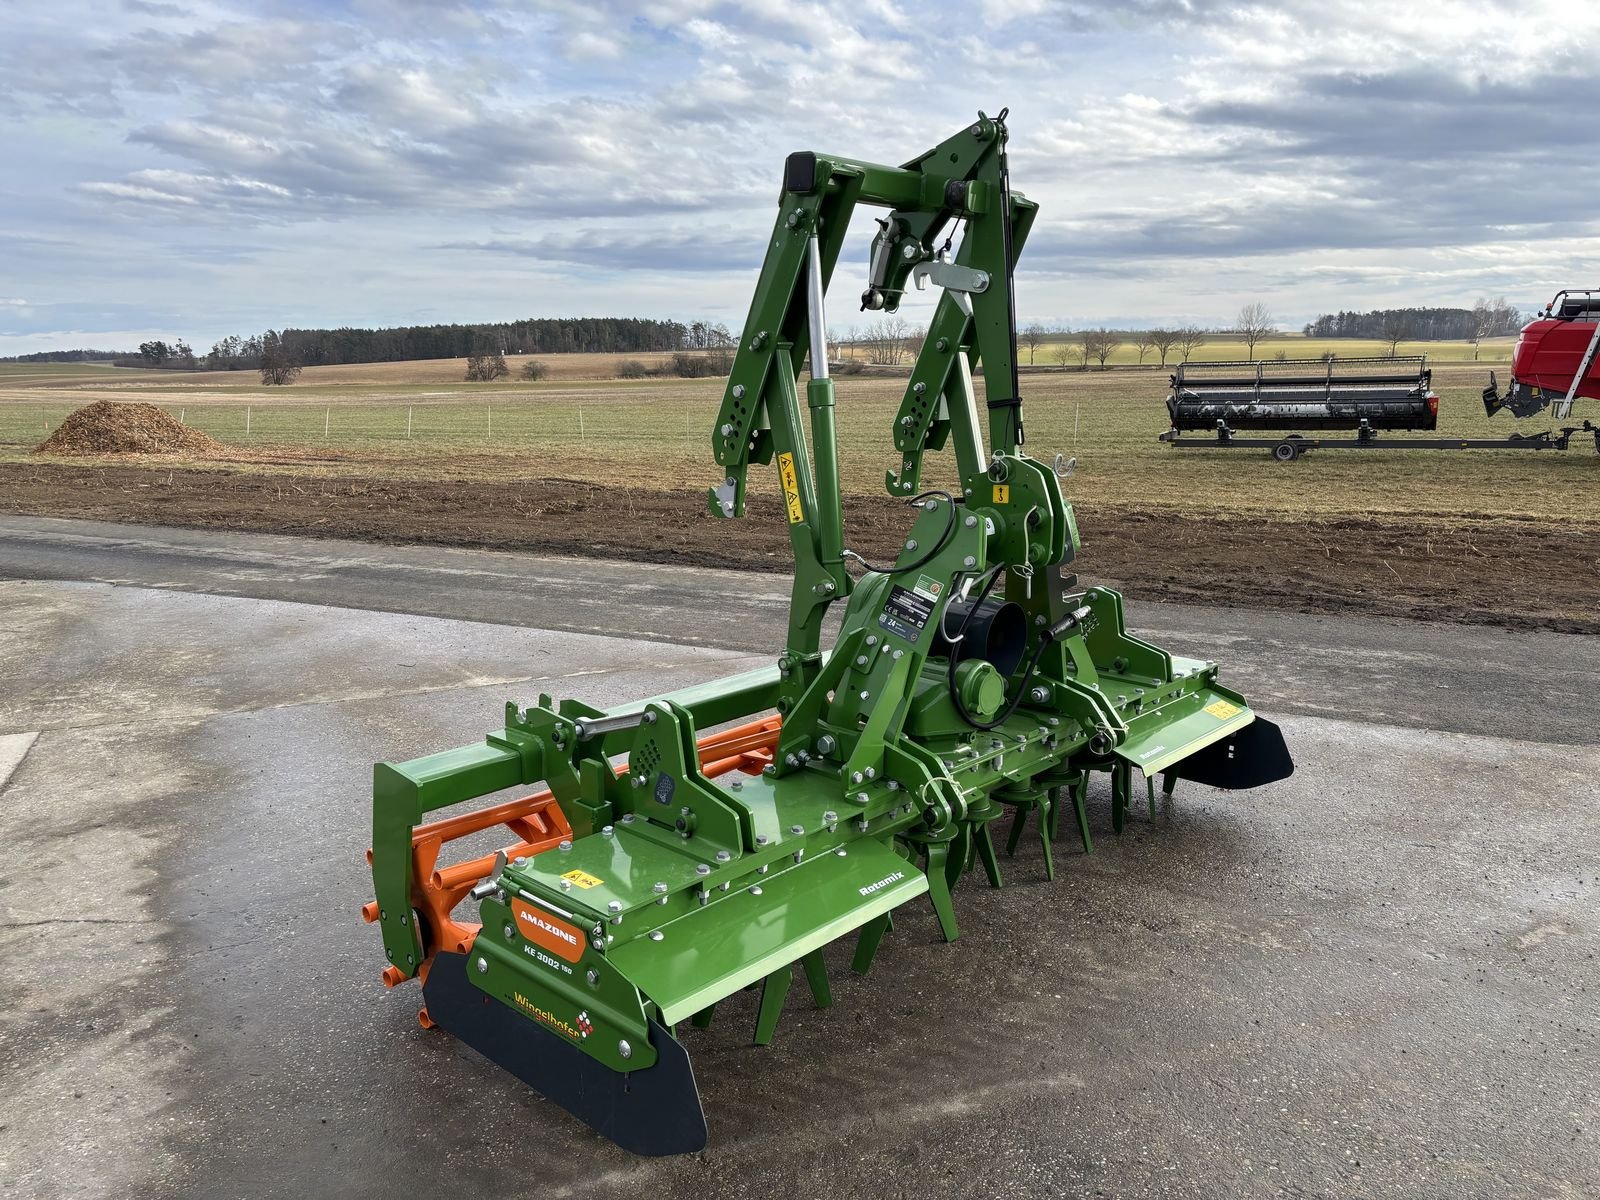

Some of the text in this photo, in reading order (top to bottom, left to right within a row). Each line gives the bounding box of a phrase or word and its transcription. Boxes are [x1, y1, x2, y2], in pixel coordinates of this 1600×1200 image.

[859, 871, 905, 896] Rotamix
[520, 910, 577, 945] AMAZONE
[524, 944, 536, 957] KE
[536, 951, 560, 970] 3002
